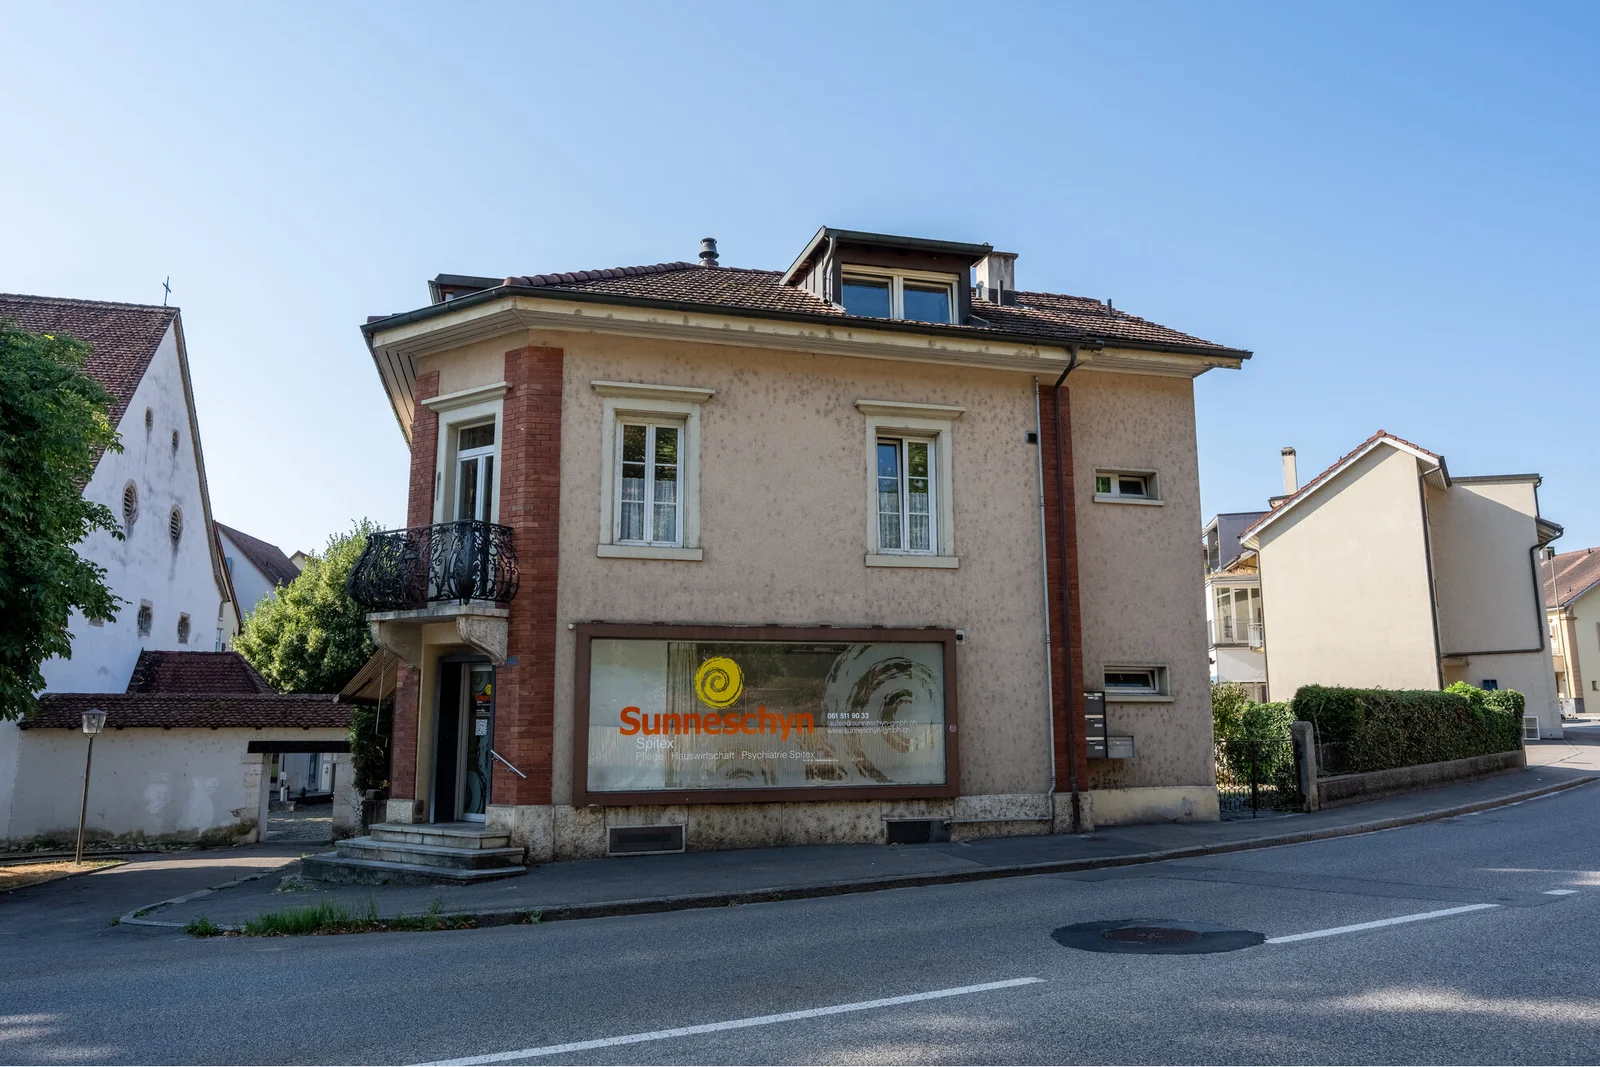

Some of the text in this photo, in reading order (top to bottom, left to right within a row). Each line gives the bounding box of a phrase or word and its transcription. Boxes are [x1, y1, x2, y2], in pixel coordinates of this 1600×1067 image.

[619, 705, 815, 742] Sunneschyn
[636, 737, 675, 752] Spitex
[635, 749, 816, 763] Pflege Hauswirtschaft Psychiatrie Spitex
